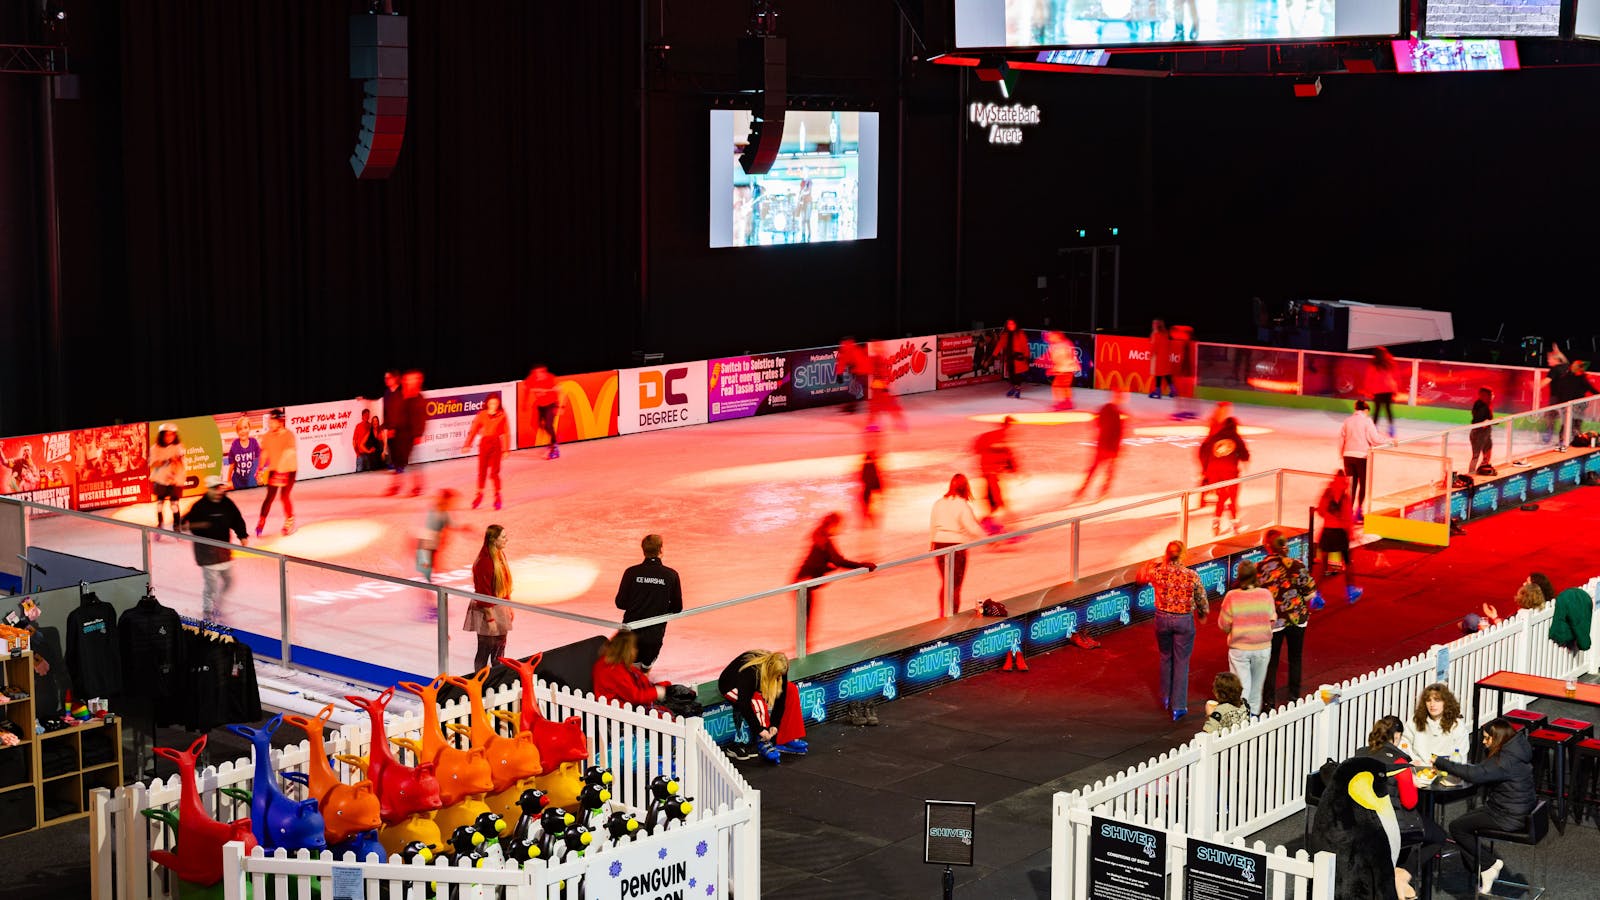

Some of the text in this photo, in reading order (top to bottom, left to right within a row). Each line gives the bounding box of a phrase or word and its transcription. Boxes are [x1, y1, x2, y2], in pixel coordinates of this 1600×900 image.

[989, 124, 1023, 143] Arena
[721, 357, 786, 374] Switch to Solstice for
[720, 373, 738, 388] great
[739, 371, 761, 384] energy
[761, 369, 778, 380] rates
[639, 367, 688, 410] DC
[720, 380, 778, 397] real Tassie service
[426, 400, 486, 416] O'Brien Elect
[639, 408, 688, 426] DEGREE C
[291, 411, 352, 425] START YOUR DAY
[295, 425, 310, 434] THE
[235, 452, 253, 462] GYM
[79, 490, 105, 502] MYSTATE
[122, 485, 141, 496] ARENA
[636, 576, 666, 586] ICE MARSHAL
[1086, 596, 1130, 622] SHIVER
[1031, 611, 1077, 640] SHIVER
[972, 628, 1022, 658] SHIVER
[907, 646, 961, 677] SHIVER
[839, 665, 896, 698] SHIVER
[929, 827, 972, 839] SHIVER
[1101, 823, 1157, 848] SHIVER
[1196, 846, 1256, 872] SHIVER
[620, 860, 687, 900] PENGUIN
